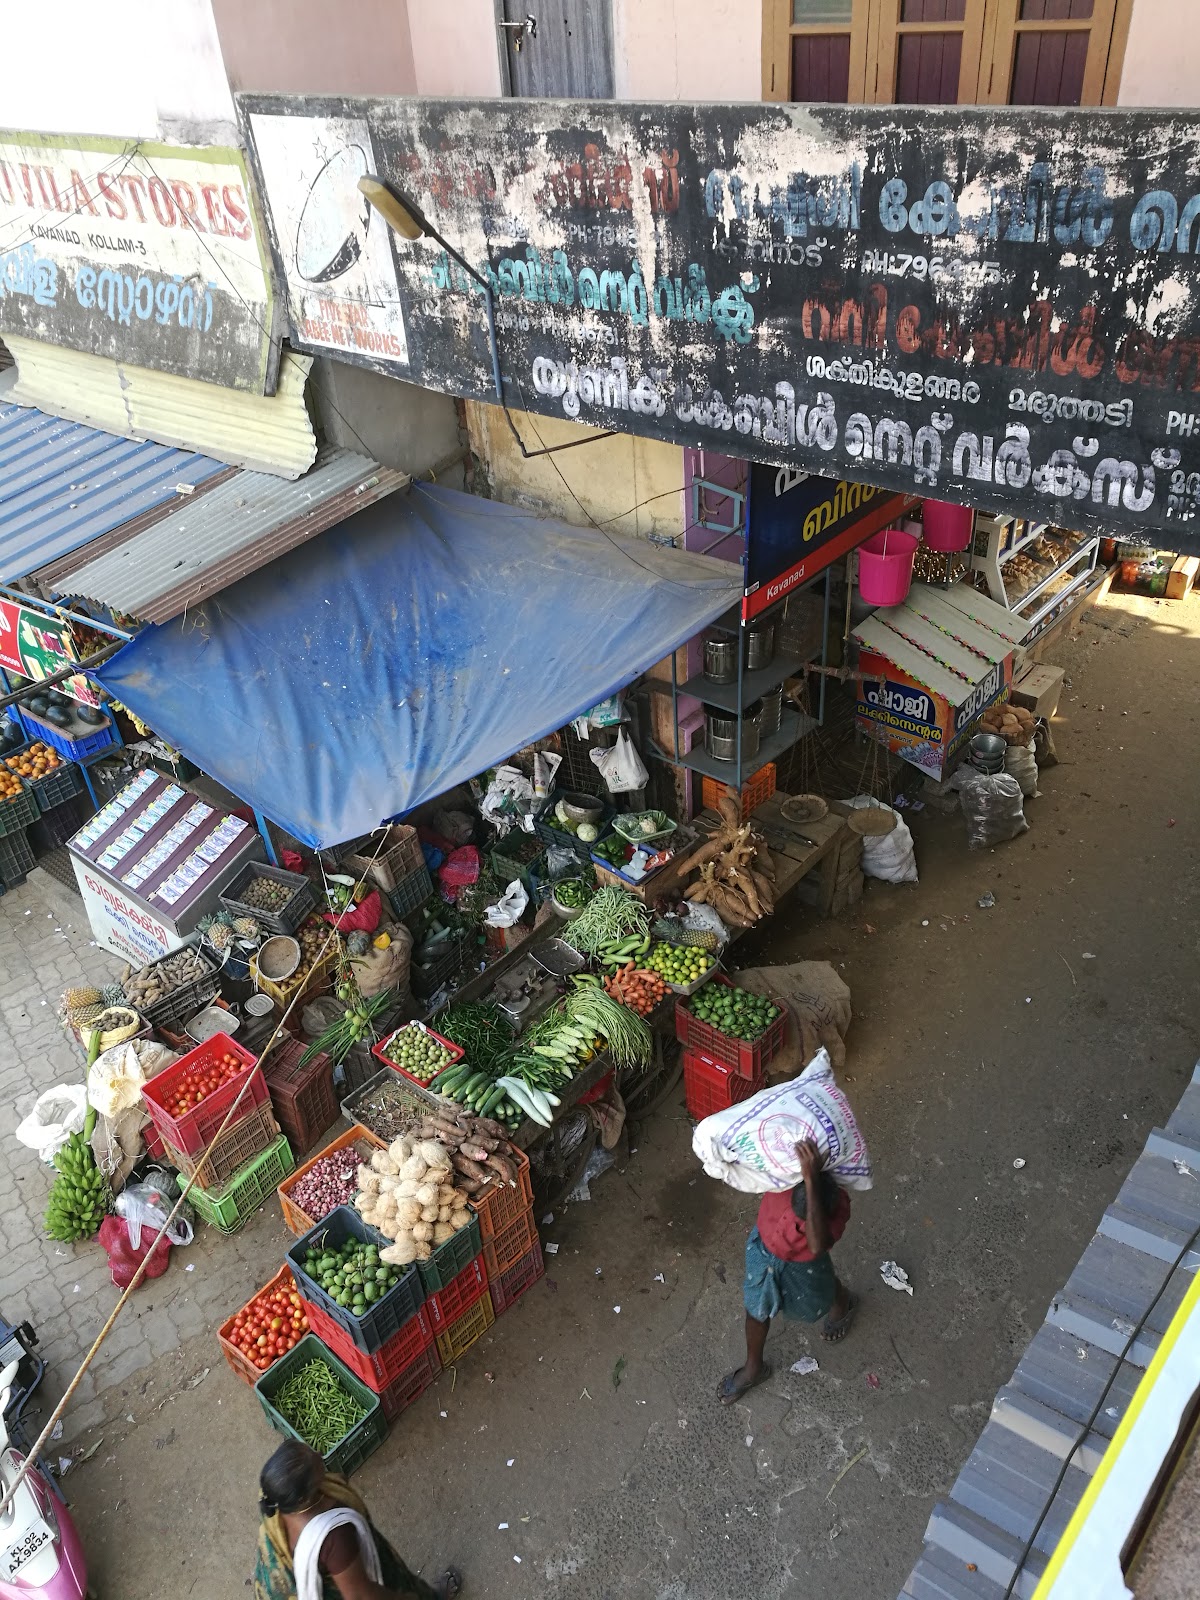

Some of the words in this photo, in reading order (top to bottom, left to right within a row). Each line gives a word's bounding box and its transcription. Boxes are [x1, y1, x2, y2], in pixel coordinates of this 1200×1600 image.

[97, 172, 252, 241] STORES
[88, 233, 147, 255] KOLLAM-3
[767, 564, 805, 600] Kavanad
[800, 1094, 832, 1128] FLOUR
